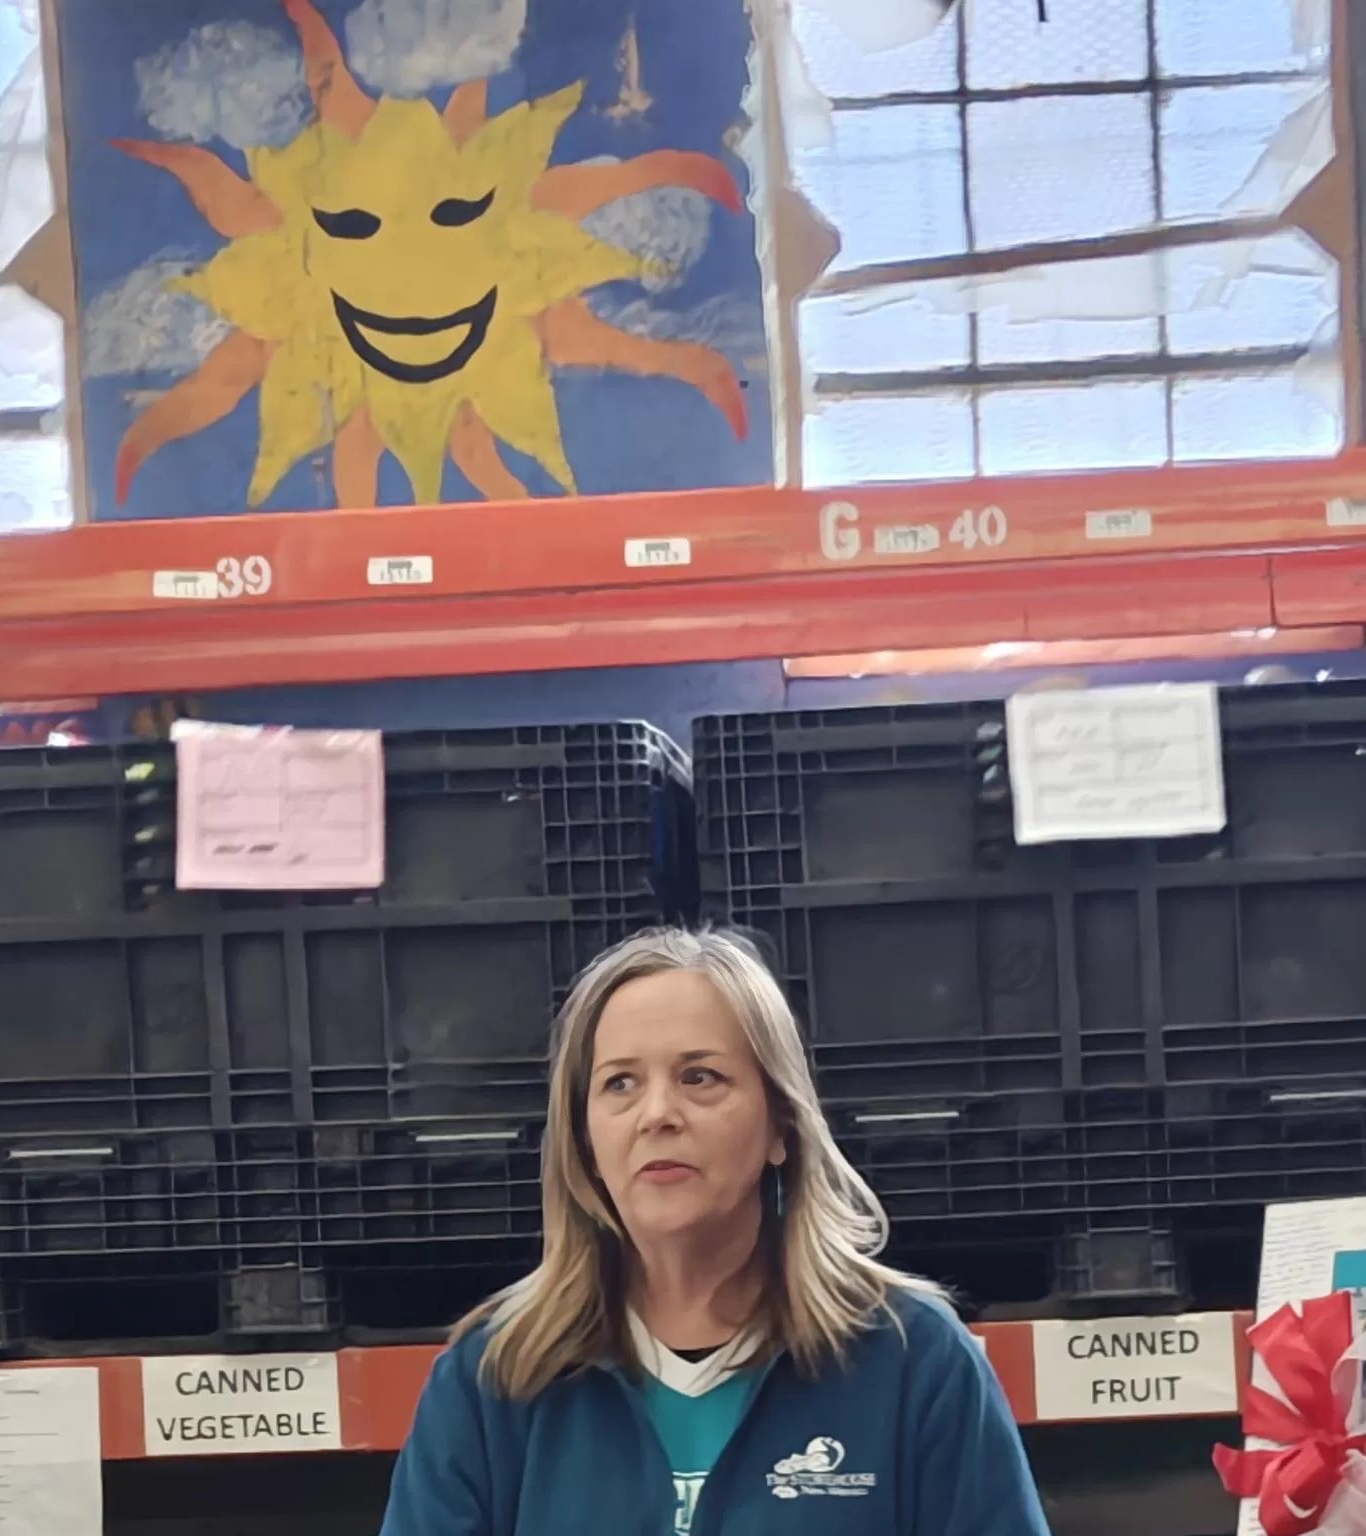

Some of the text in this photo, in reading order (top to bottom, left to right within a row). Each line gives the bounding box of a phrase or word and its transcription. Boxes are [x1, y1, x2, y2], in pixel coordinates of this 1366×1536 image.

[819, 501, 861, 560] G
[948, 505, 1006, 549] 40
[216, 555, 272, 598] 39
[1067, 1330, 1200, 1359] CANNED
[175, 1366, 305, 1396] CANNED
[1091, 1376, 1182, 1404] FRUIT
[156, 1411, 332, 1441] VEGETABLE
